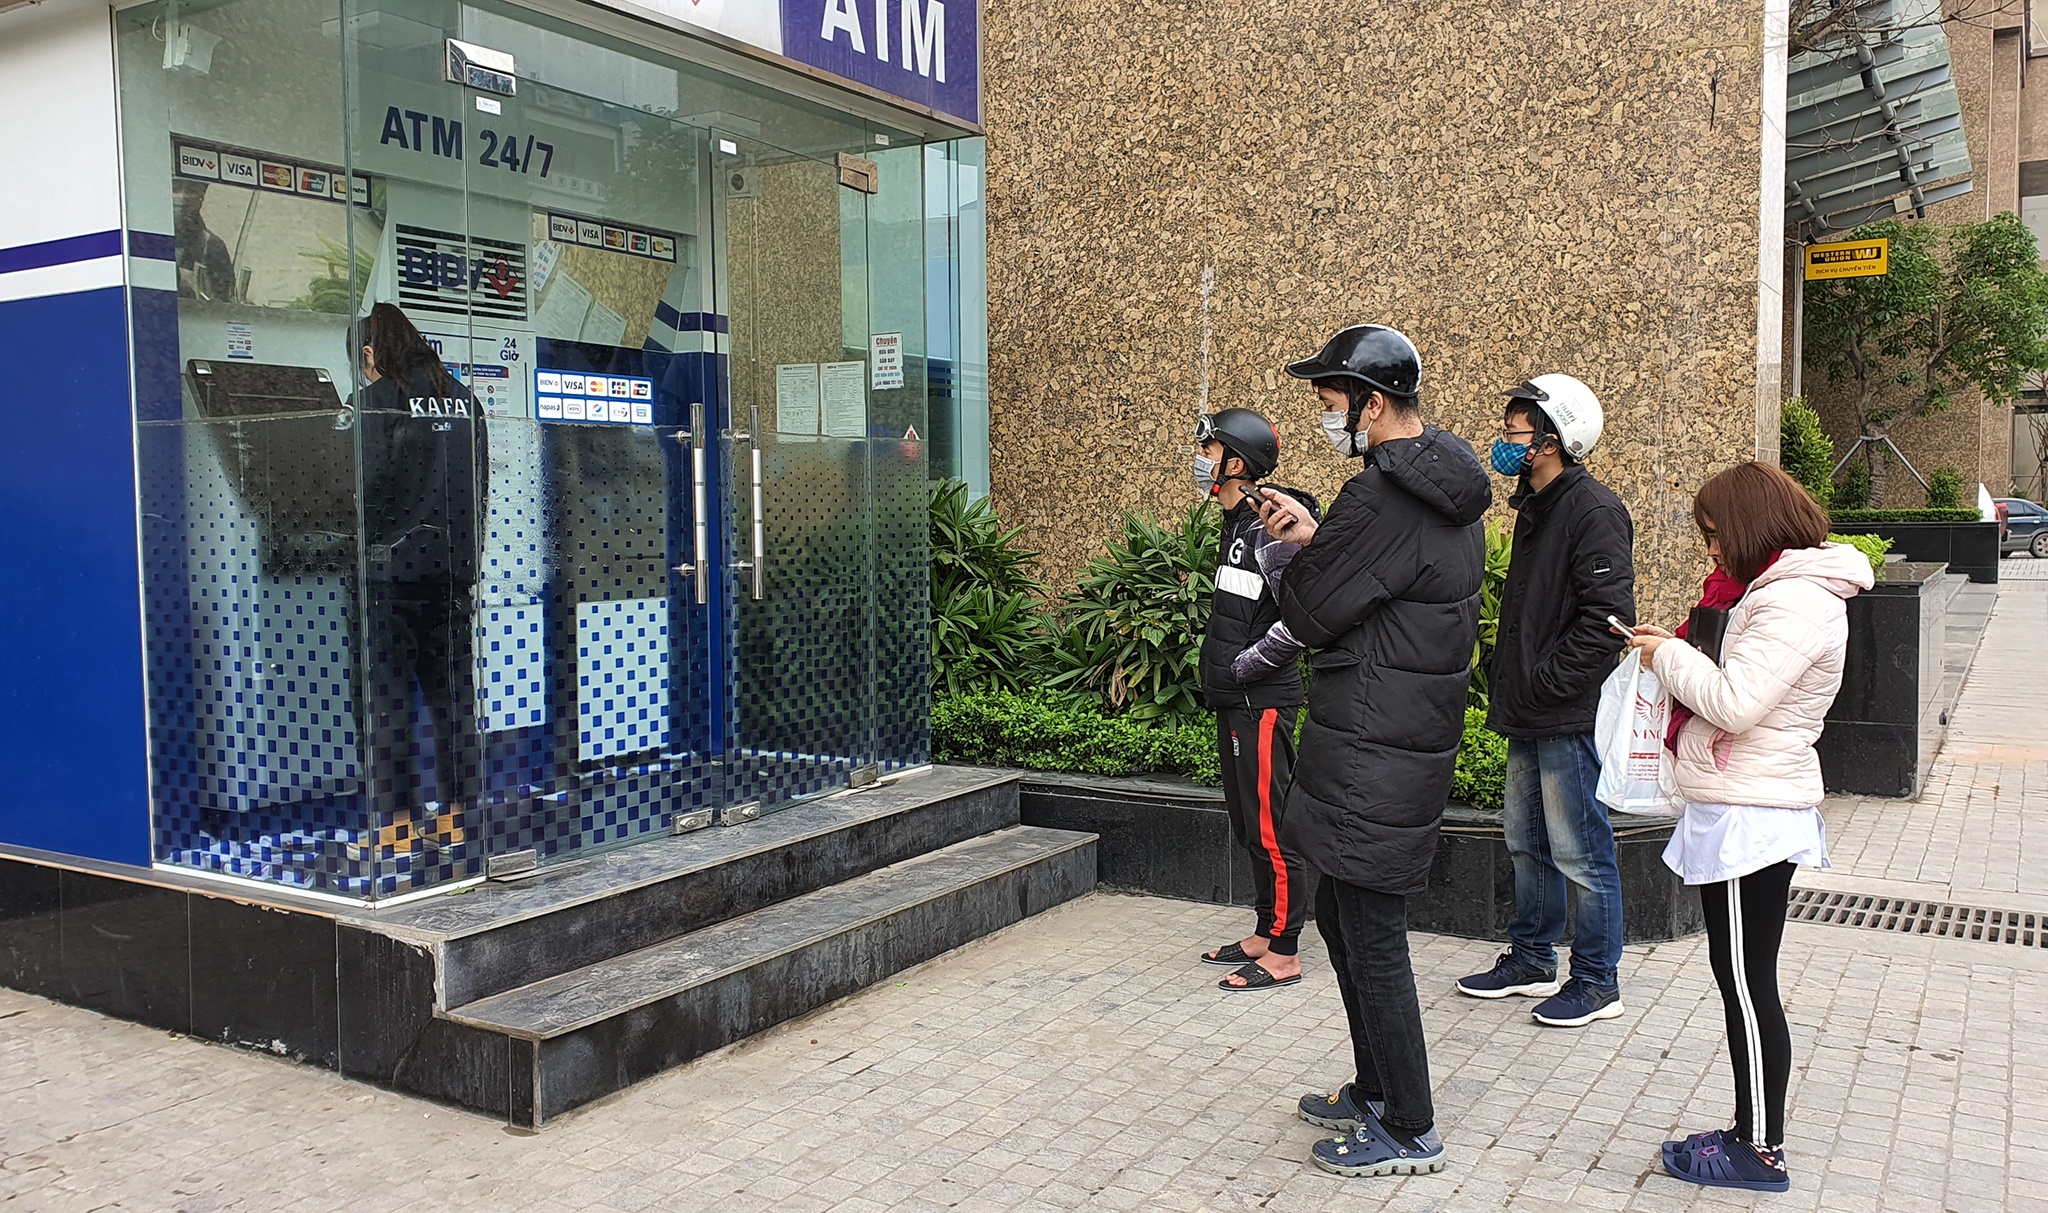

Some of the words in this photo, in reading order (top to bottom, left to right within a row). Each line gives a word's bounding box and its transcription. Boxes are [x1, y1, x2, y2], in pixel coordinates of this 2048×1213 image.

[821, 0, 946, 83] ATM
[380, 105, 463, 160] ATM
[479, 129, 554, 178] 24/7
[182, 155, 206, 168] BIDV
[226, 161, 253, 177] VISA
[553, 222, 569, 233] BIDV
[581, 228, 600, 240] VISA
[1855, 248, 1877, 259] WU
[404, 246, 486, 291] BIDV
[503, 336, 517, 349] 24
[564, 380, 583, 390] VISA
[408, 396, 469, 418] KAFA
[1559, 402, 1577, 422] nutri
[1229, 538, 1244, 565] G
